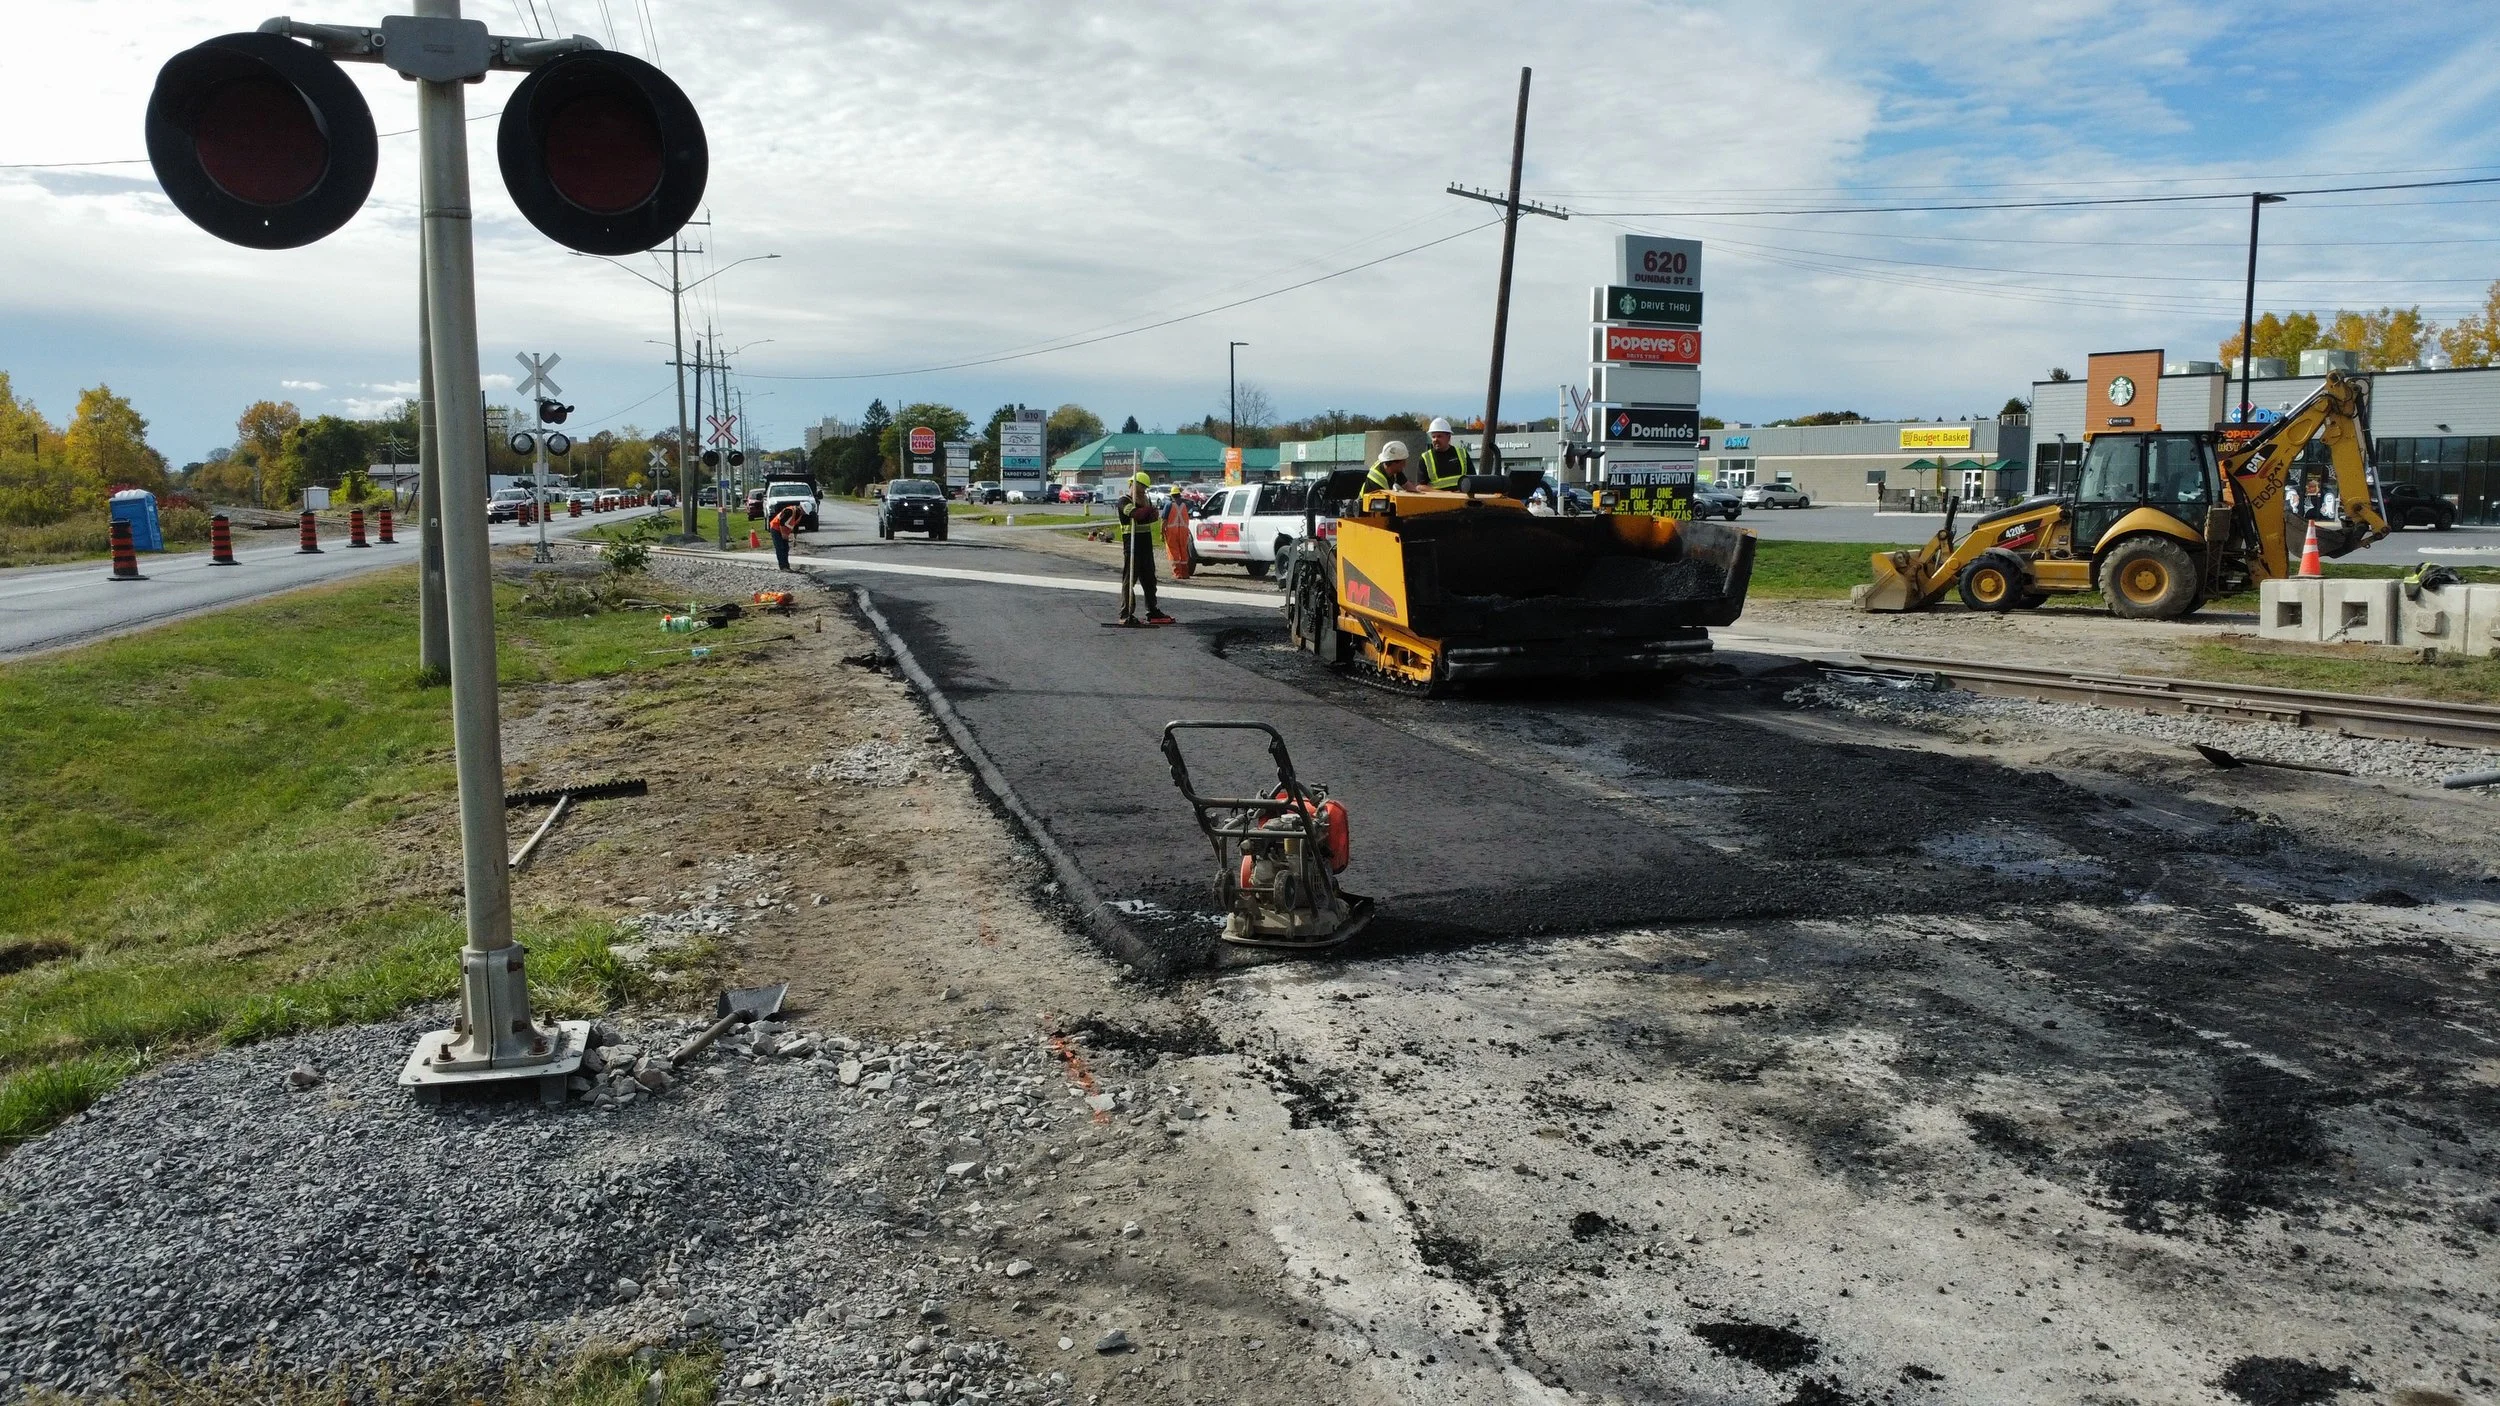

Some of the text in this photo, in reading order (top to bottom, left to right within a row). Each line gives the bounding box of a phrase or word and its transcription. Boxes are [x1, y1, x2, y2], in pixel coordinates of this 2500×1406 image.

[1643, 250, 1687, 274] 620
[1635, 273, 1693, 286] DUNDAS ST E
[1640, 301, 1691, 312] DRIVE THRU
[1024, 412, 1039, 420] 610
[1631, 423, 1694, 439] Domino's
[1913, 433, 1969, 446] Budget Basket
[2246, 452, 2267, 473] CAT
[1610, 472, 1692, 485] ALL DAY EVERYDAY
[1630, 487, 1673, 499] BUY ONE
[1633, 500, 1649, 511] ONE
[1652, 499, 1669, 511] 50%
[1673, 499, 1687, 510] OFF
[2005, 524, 2027, 538] 420E
